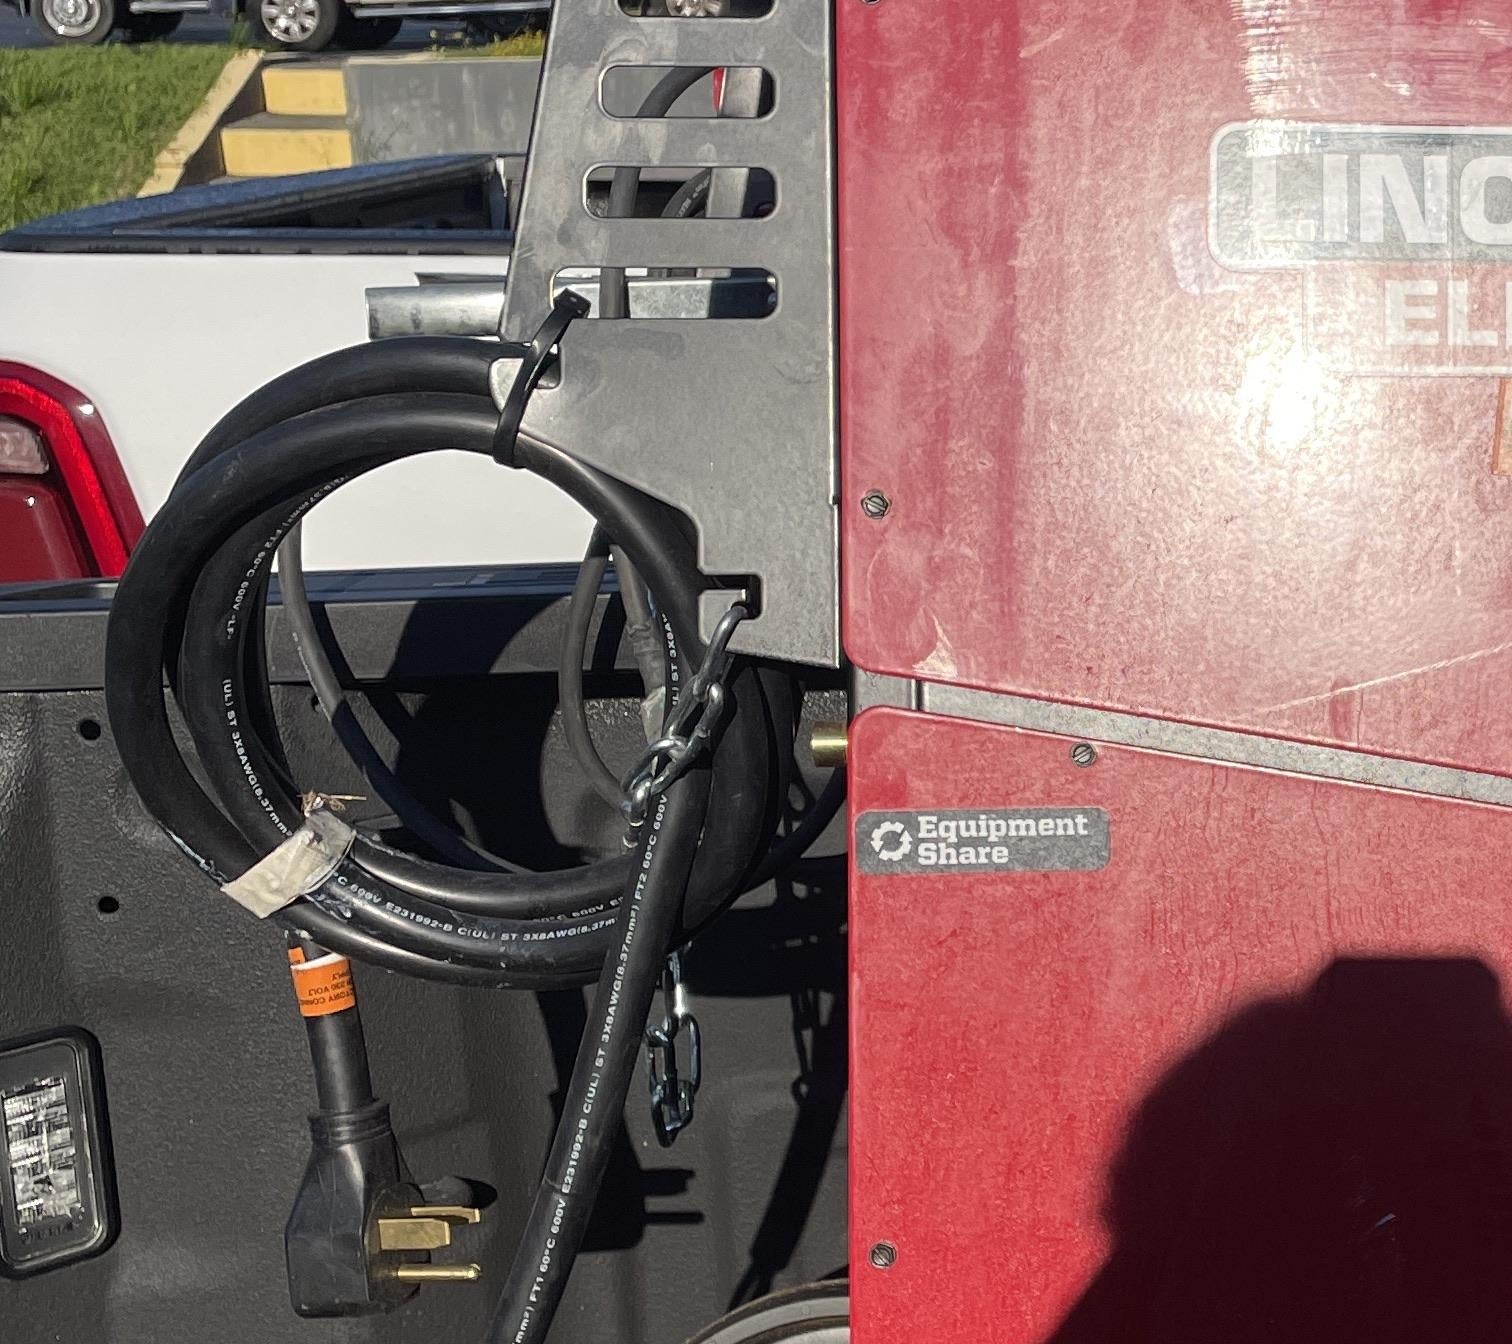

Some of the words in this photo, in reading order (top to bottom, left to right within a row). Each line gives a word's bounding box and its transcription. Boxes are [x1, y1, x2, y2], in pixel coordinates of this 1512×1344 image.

[233, 581, 249, 611] 600V
[227, 710, 237, 726] ST
[917, 814, 1089, 843] Equipment
[917, 842, 1009, 865] Share
[501, 933, 518, 941] ST
[550, 1198, 567, 1234] 600V
[595, 1047, 607, 1068] ST
[653, 794, 668, 830] 600V
